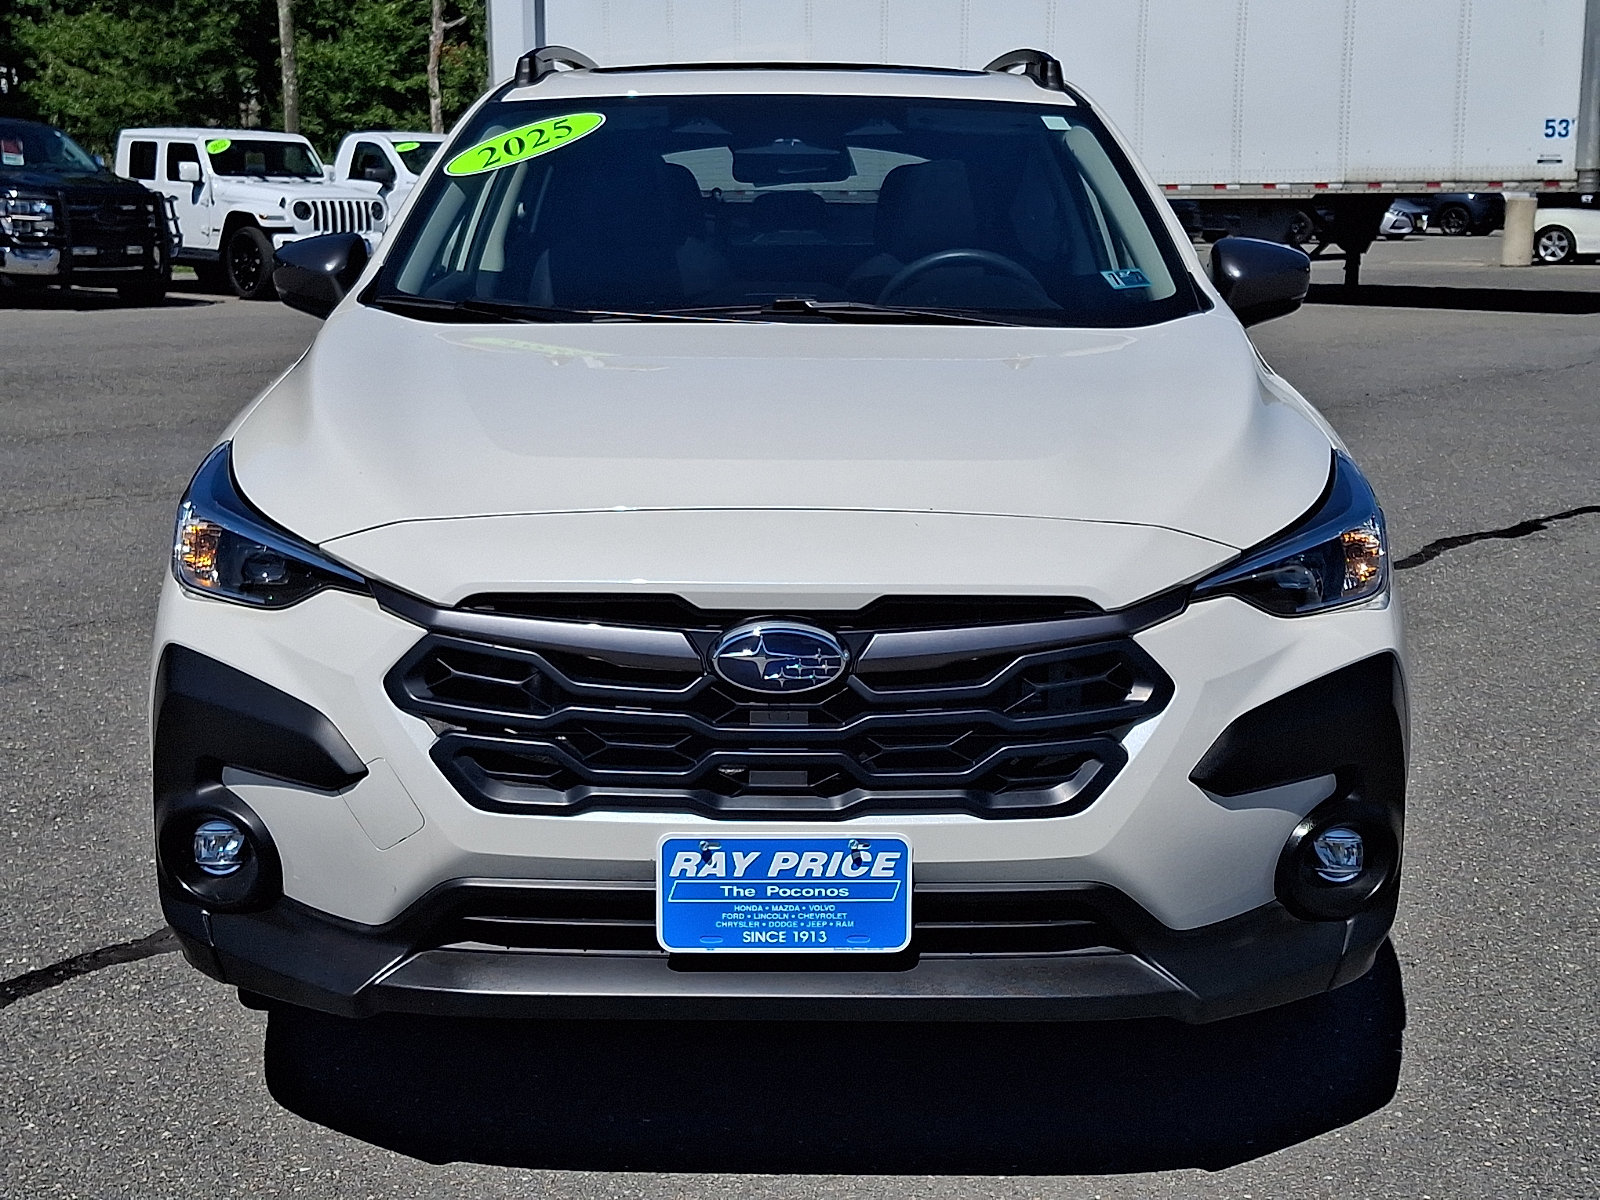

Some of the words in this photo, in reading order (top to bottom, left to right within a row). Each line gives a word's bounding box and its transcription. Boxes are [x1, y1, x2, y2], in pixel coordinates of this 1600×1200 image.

[477, 118, 573, 168] 2025
[669, 851, 762, 877] RAY
[767, 851, 902, 877] PRICE
[720, 885, 756, 897] The
[766, 885, 850, 897] Poconos
[721, 912, 745, 920] FORD
[753, 912, 789, 920] LINCOLN
[797, 912, 848, 920] CHEVROLET
[715, 920, 760, 928] CHRYSLER
[768, 920, 798, 928] DODGE
[806, 920, 828, 928] JEEP
[835, 920, 855, 928] RAM
[742, 931, 787, 943] SINCE
[793, 931, 827, 943] 1913
